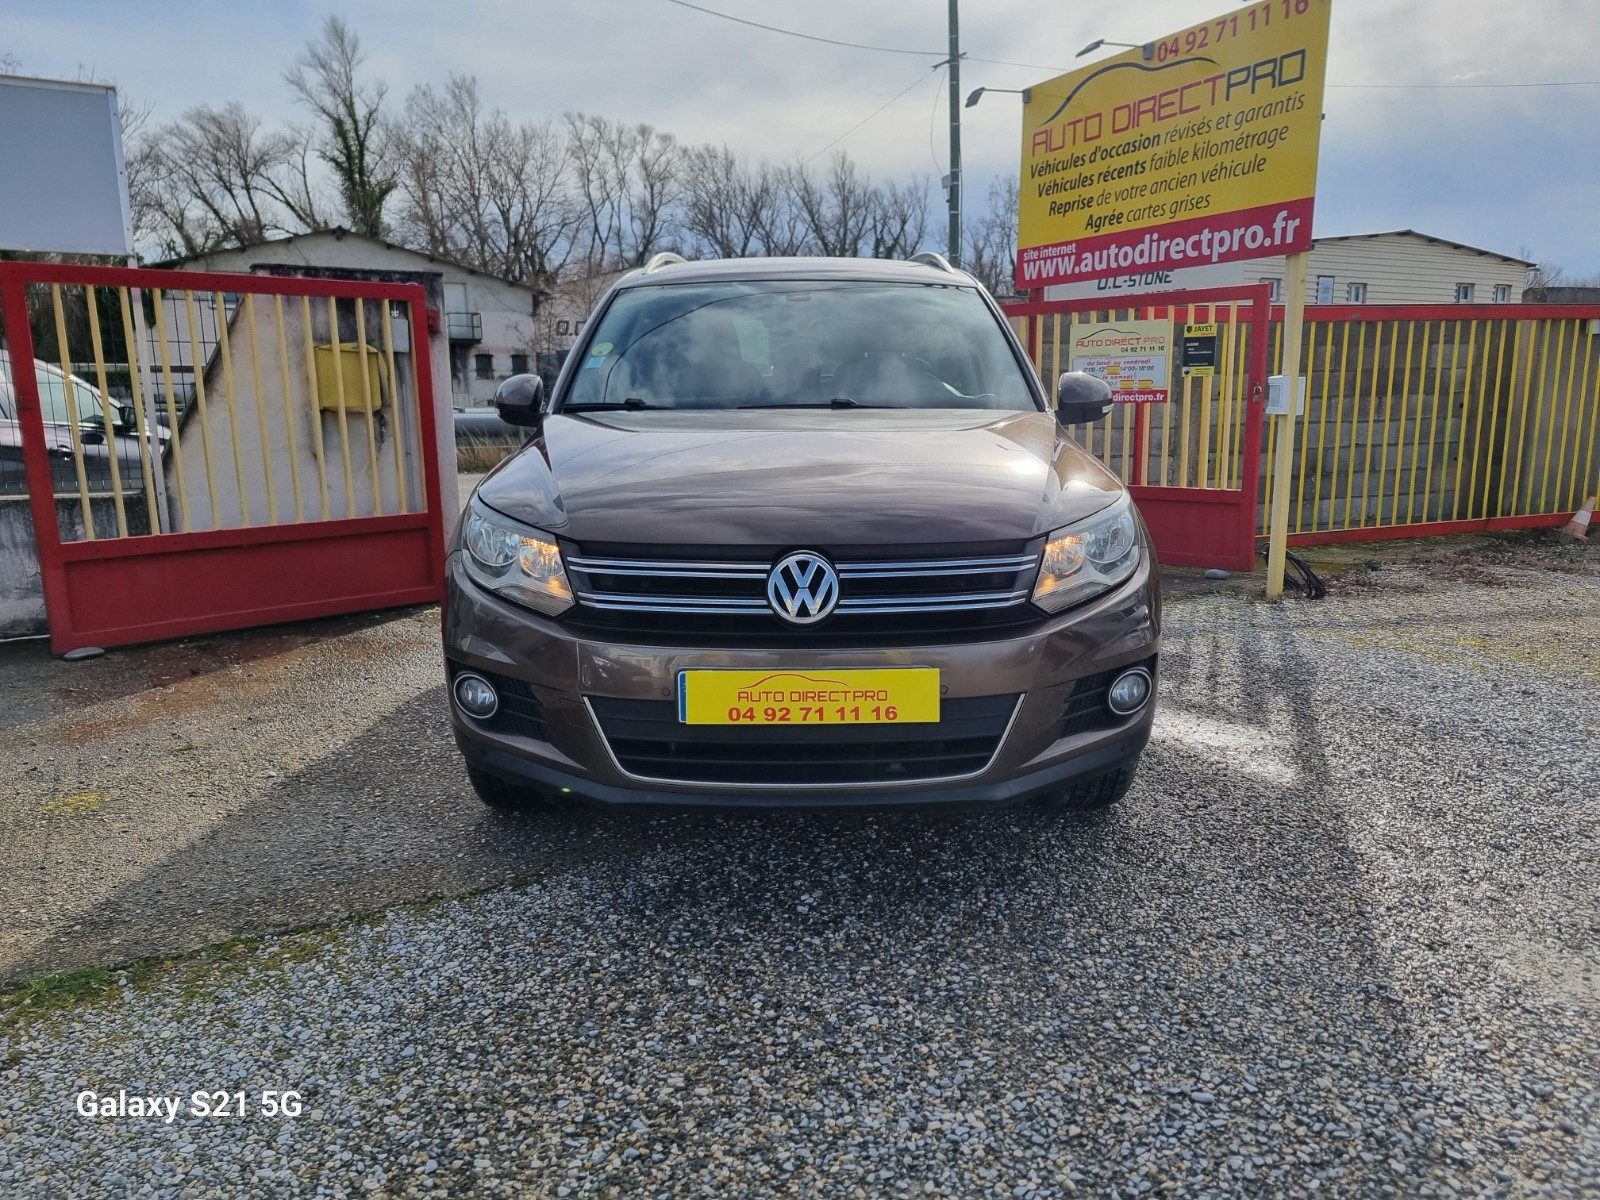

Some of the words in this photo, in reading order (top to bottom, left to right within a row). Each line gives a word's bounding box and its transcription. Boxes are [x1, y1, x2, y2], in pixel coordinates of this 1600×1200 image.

[1157, 37, 1180, 62] 04
[1185, 27, 1209, 53] 92
[1215, 16, 1238, 43] 71
[1248, 3, 1271, 31] 11
[1282, 0, 1309, 19] 16
[1030, 153, 1086, 179] Véhicules
[1089, 133, 1160, 164] d'occasion
[1164, 116, 1213, 144] révisés
[1216, 112, 1232, 130] et
[1234, 91, 1306, 131] garantis
[1032, 112, 1102, 157] AUTO
[1038, 172, 1095, 198] Véhicules
[1097, 160, 1146, 184] récents
[1149, 147, 1189, 172] faible
[1192, 125, 1289, 162] kilométrage
[1048, 195, 1094, 217] Reprise
[1096, 189, 1112, 206] de
[1114, 184, 1148, 203] votre
[1150, 172, 1197, 195] ancien
[1201, 153, 1267, 184] véhicule
[1085, 209, 1124, 233] Agrée
[1126, 203, 1167, 222] cartes
[1169, 194, 1211, 219] grises
[1023, 210, 1301, 281] www.autodirectpro.fr
[1023, 248, 1039, 261] site
[1040, 242, 1077, 258] internet
[1076, 339, 1103, 348] AUTO
[1112, 392, 1165, 402] directpro.fr
[728, 706, 756, 722] 04
[763, 706, 791, 722] 92
[799, 706, 824, 722] 71
[835, 706, 860, 721] 11
[871, 705, 898, 721] 16
[737, 690, 785, 703] AUTO
